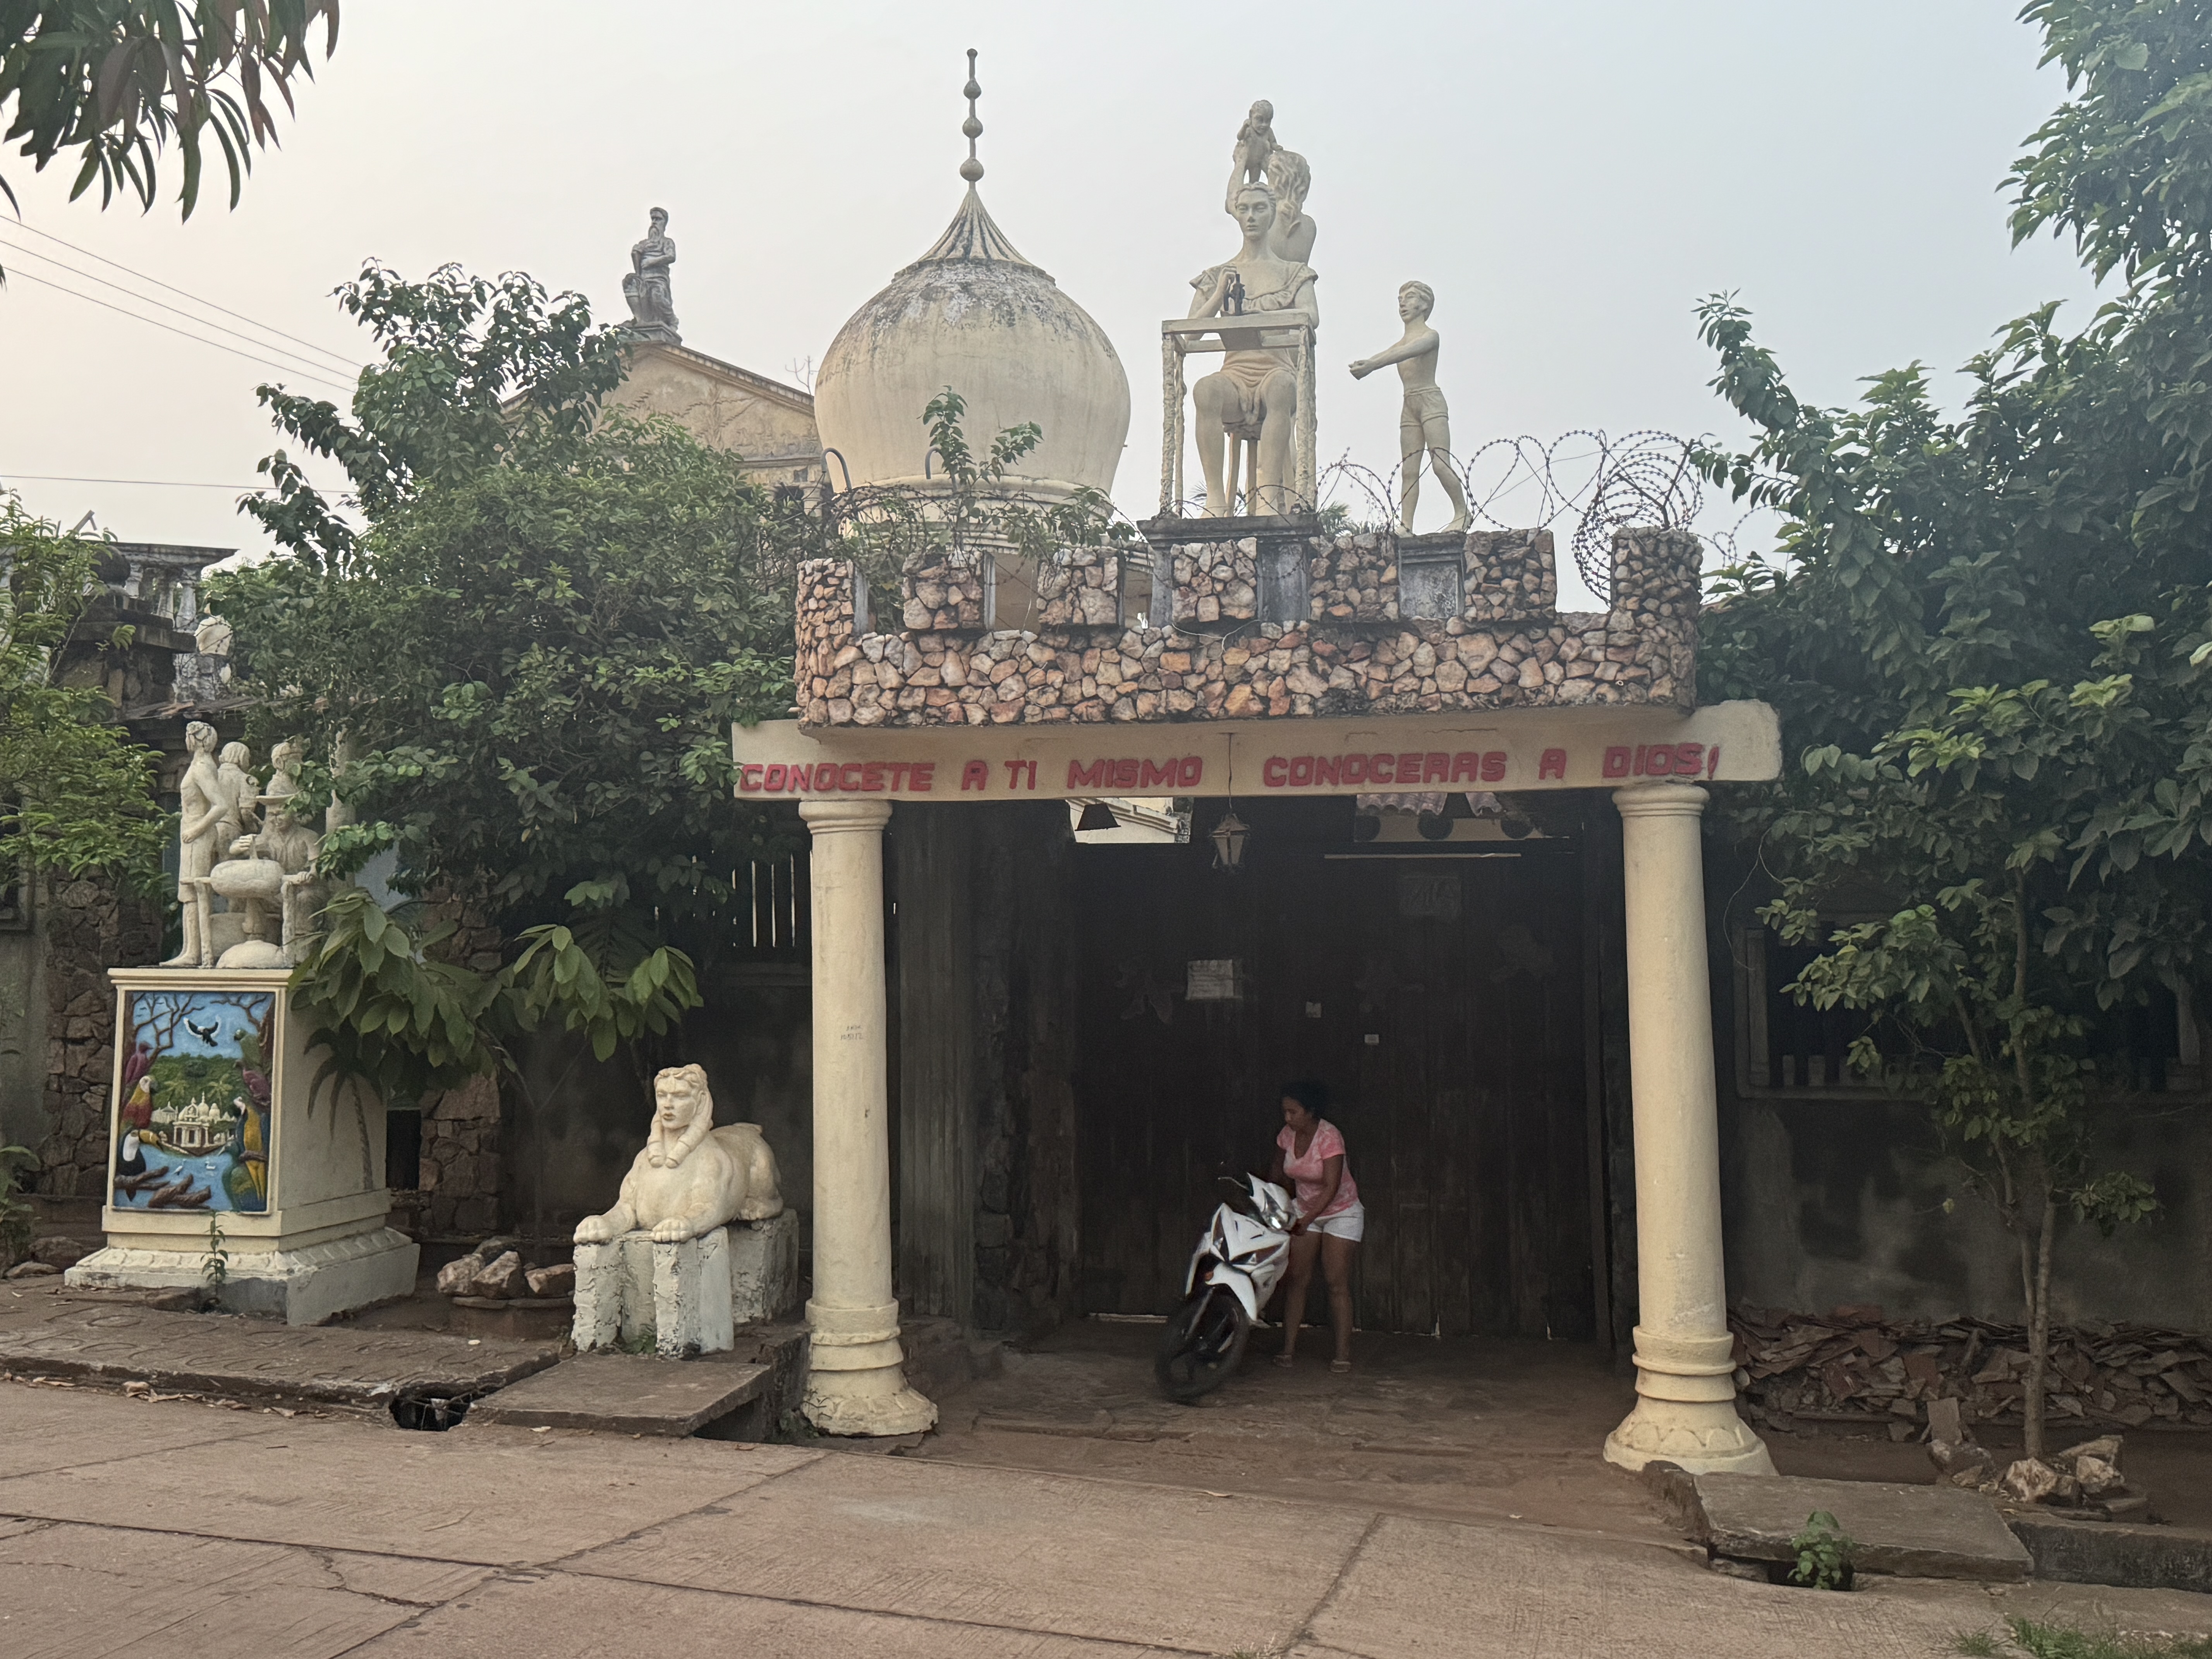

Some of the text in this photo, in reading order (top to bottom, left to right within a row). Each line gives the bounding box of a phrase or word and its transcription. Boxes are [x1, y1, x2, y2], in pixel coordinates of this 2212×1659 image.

[738, 744, 1719, 792] CONOCETE A TI MISMO CONOCERAS A DIOS!
